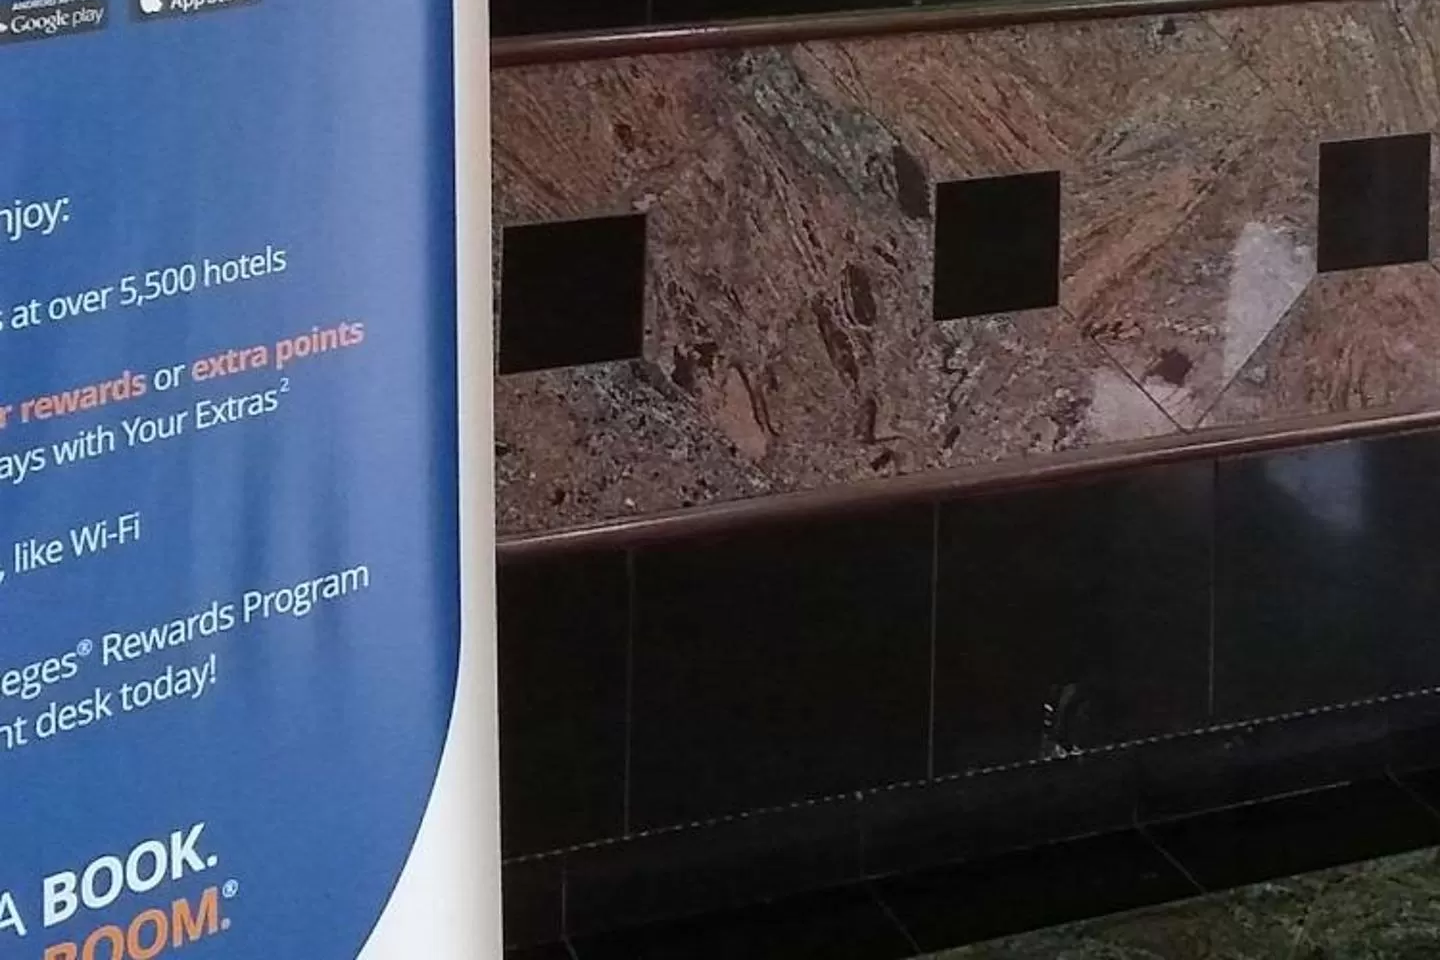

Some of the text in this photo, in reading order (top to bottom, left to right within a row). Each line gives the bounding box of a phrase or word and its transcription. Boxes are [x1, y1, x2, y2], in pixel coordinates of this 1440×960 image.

[10, 6, 105, 34] Google play
[11, 299, 42, 329] at
[48, 287, 114, 320] over
[120, 264, 196, 306] 5,500
[203, 245, 287, 287] hotels
[20, 369, 148, 424] rewards
[154, 362, 184, 391] or
[191, 344, 268, 382] extra
[276, 318, 365, 370] points
[53, 424, 115, 465] with
[122, 410, 189, 446] Your
[15, 511, 140, 573] like Wi-Fi
[102, 602, 235, 665] Rewards
[243, 564, 370, 623] Program
[36, 688, 113, 739] desk
[119, 653, 217, 712] today!
[43, 822, 219, 927] BOOK.
